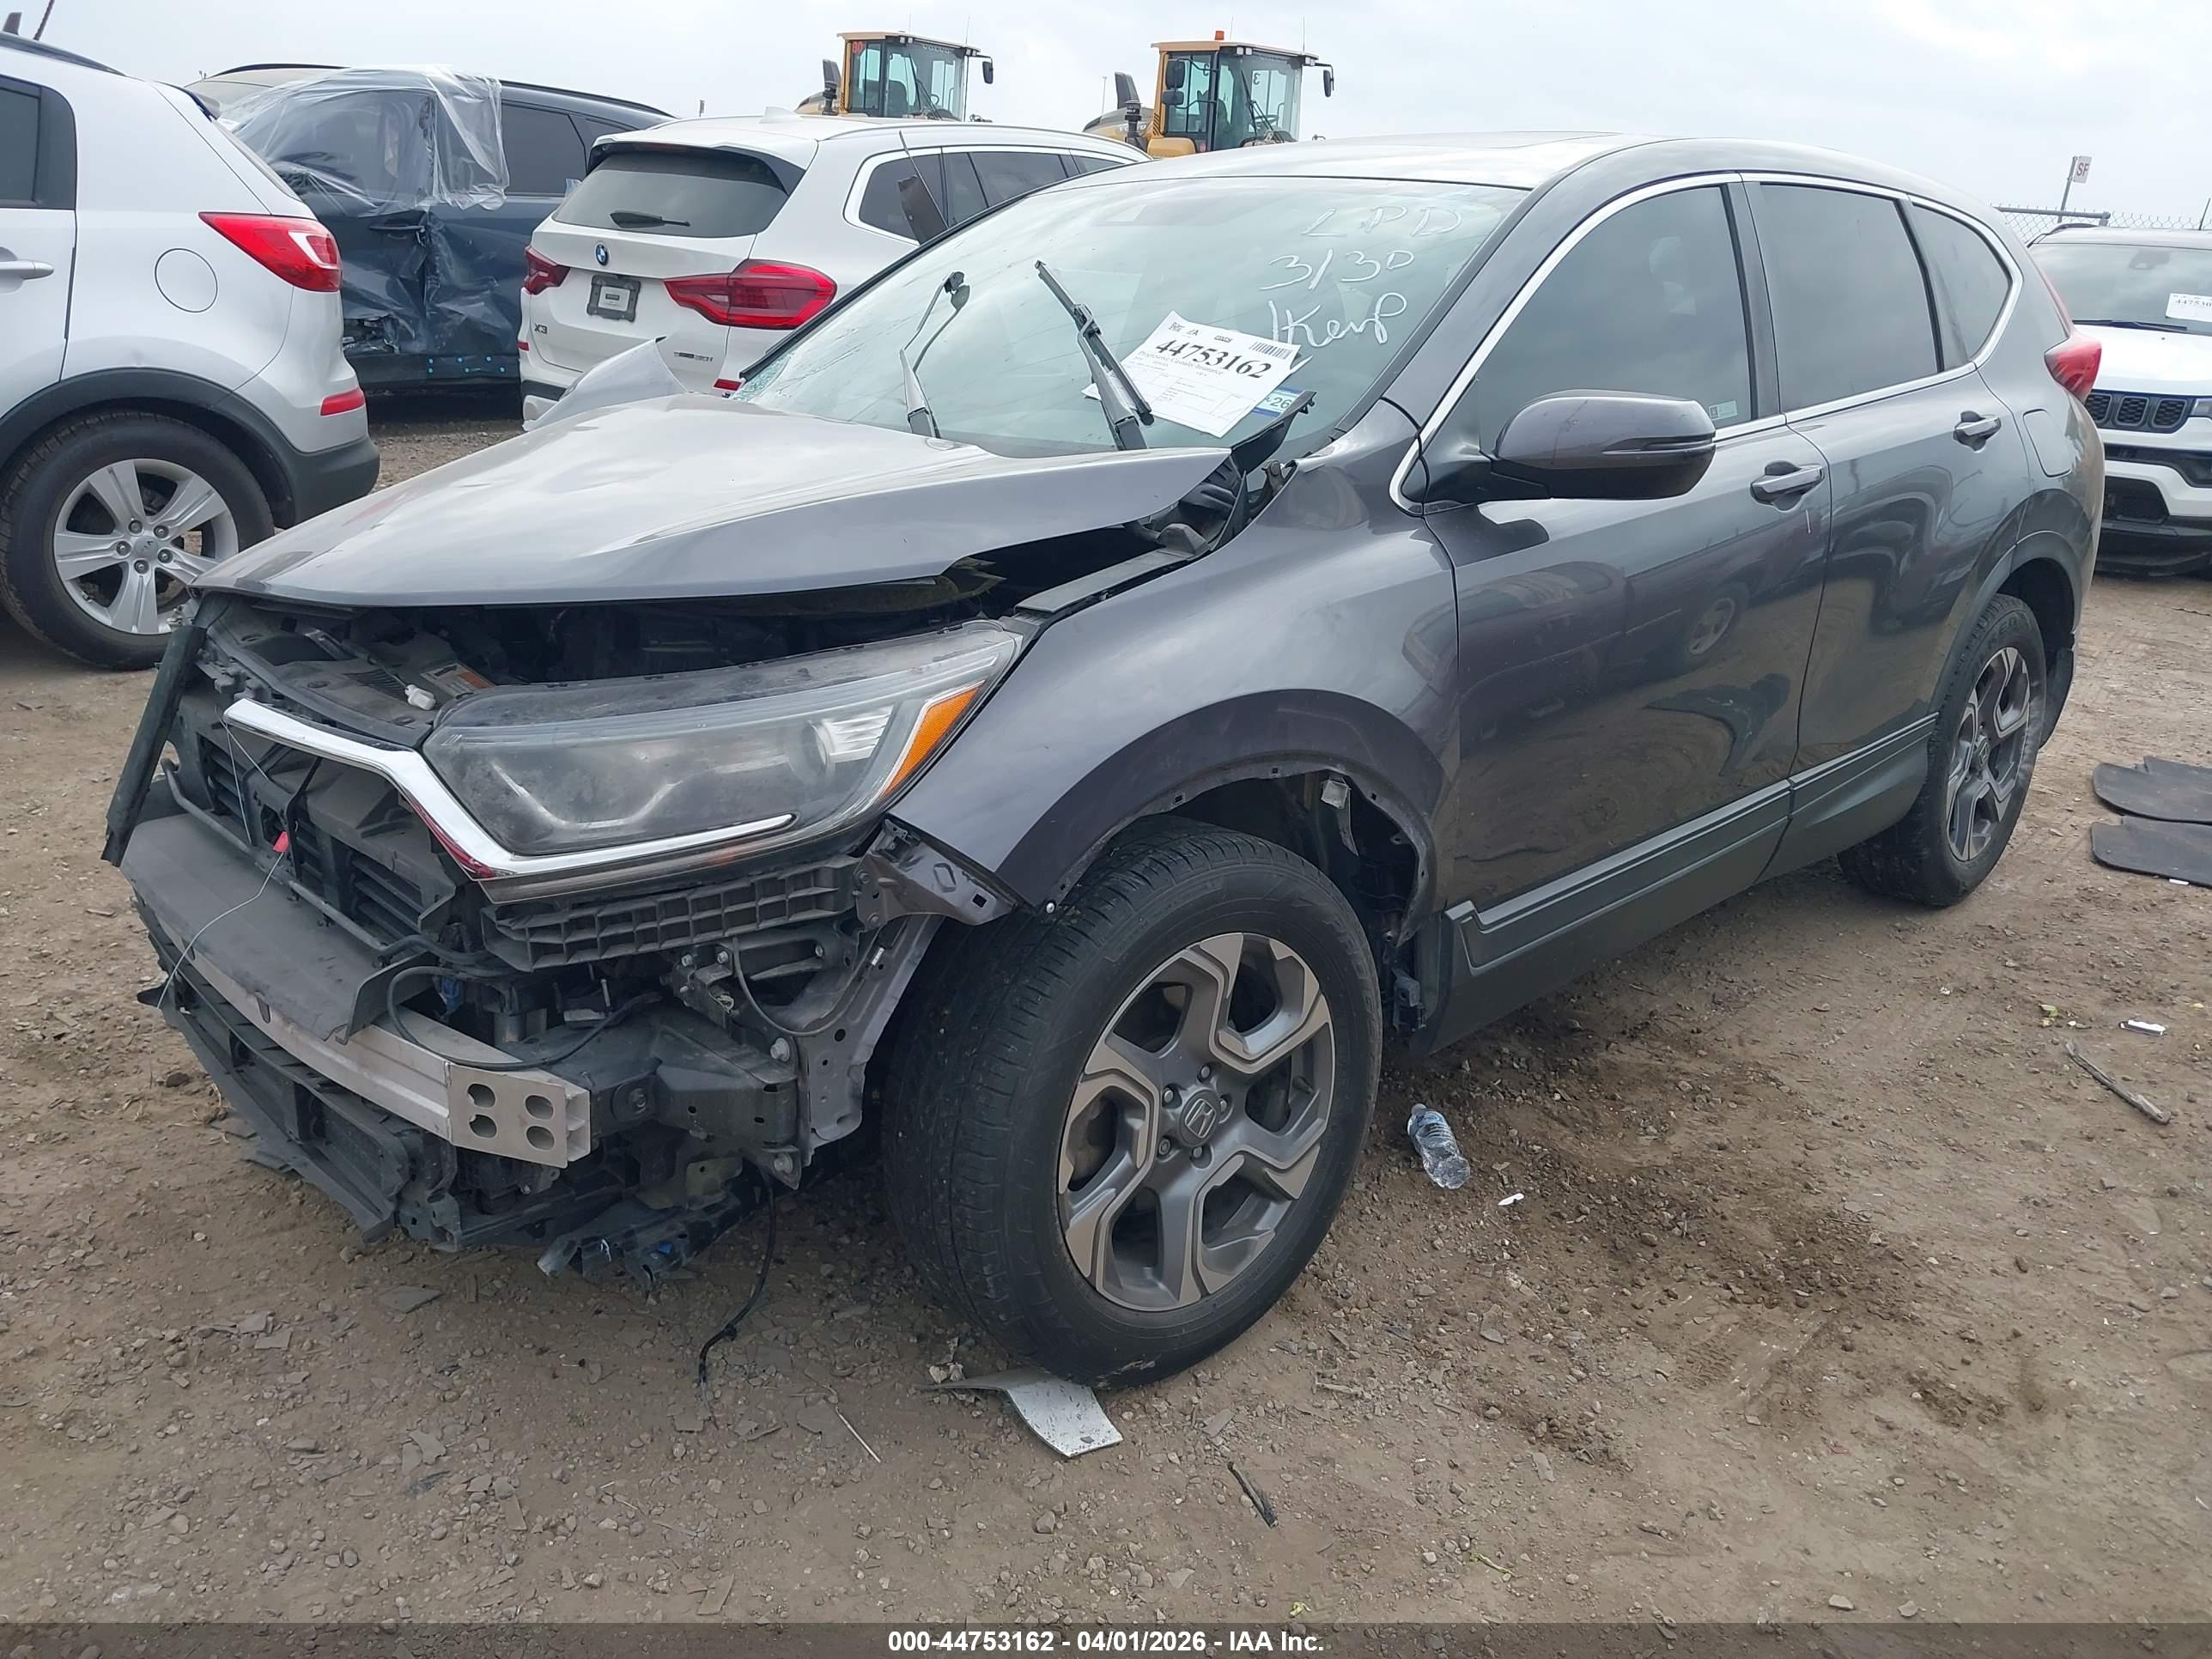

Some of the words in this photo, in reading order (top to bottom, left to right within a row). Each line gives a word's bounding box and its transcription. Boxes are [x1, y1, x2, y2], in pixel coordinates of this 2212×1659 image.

[1259, 248, 1415, 290] 3/30
[534, 323, 548, 334] X3
[1155, 339, 1272, 379] 44753162
